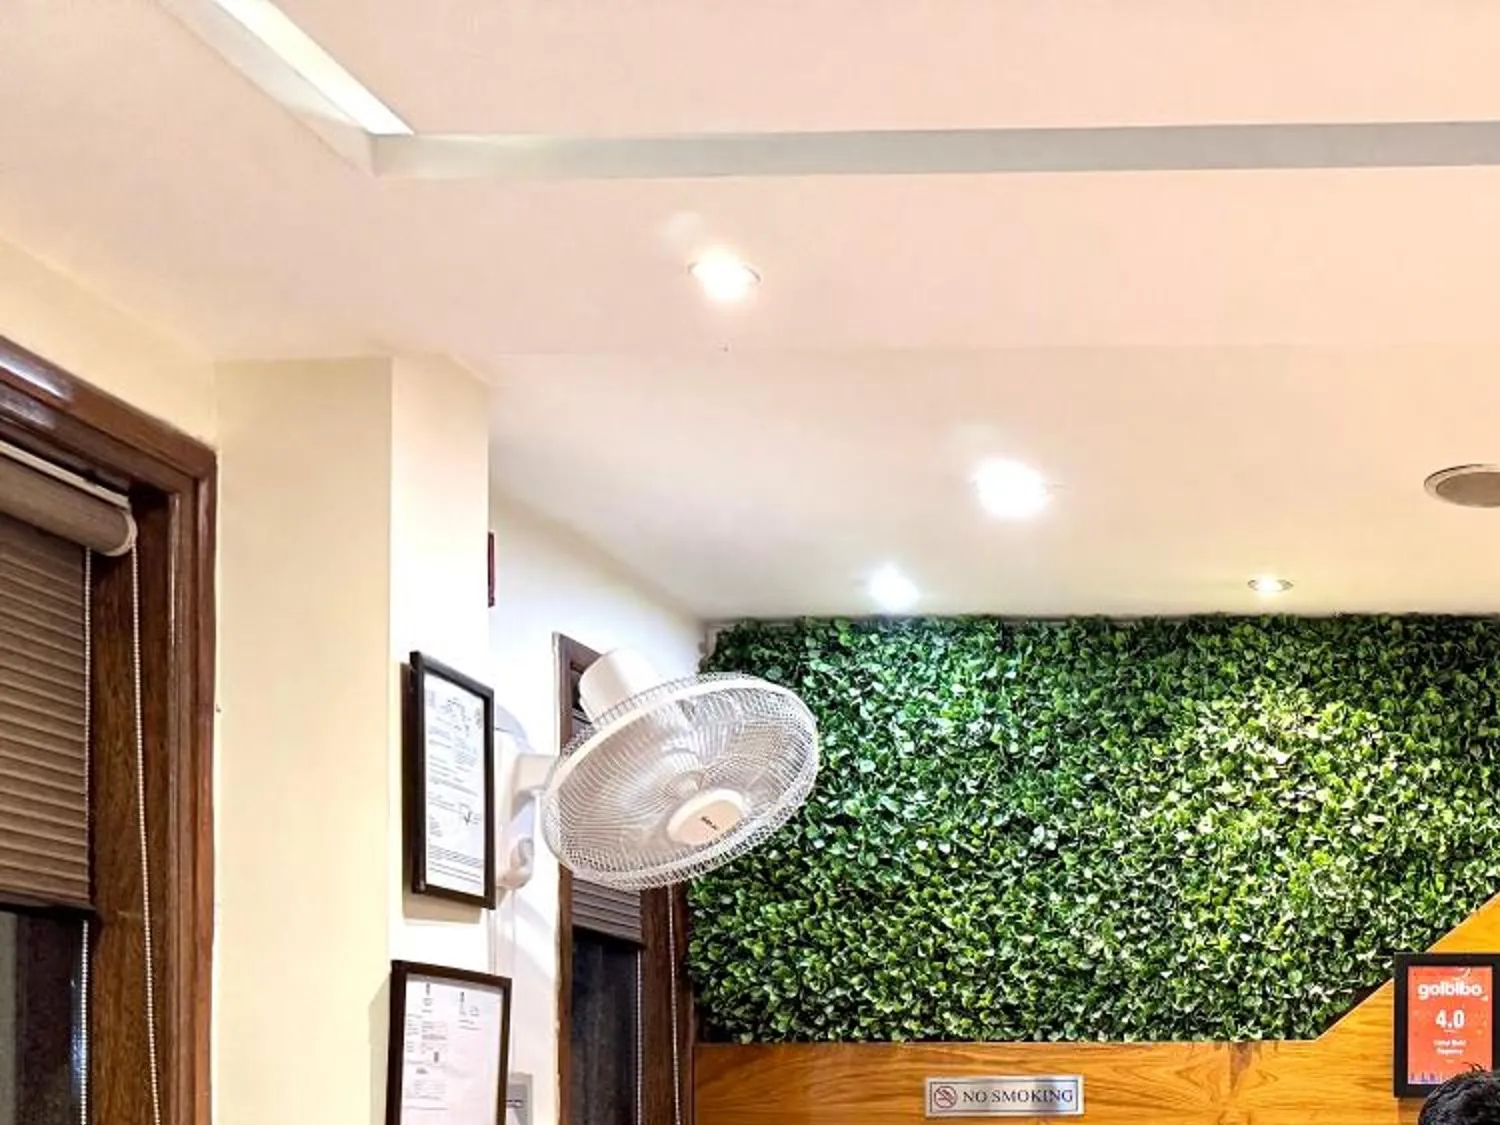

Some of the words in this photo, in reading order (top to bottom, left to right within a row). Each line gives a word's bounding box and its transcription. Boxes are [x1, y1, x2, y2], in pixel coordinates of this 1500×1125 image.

[1435, 1009, 1465, 1029] 4.0
[963, 1091, 987, 1103] NO
[991, 1089, 1073, 1103] SMOKING
